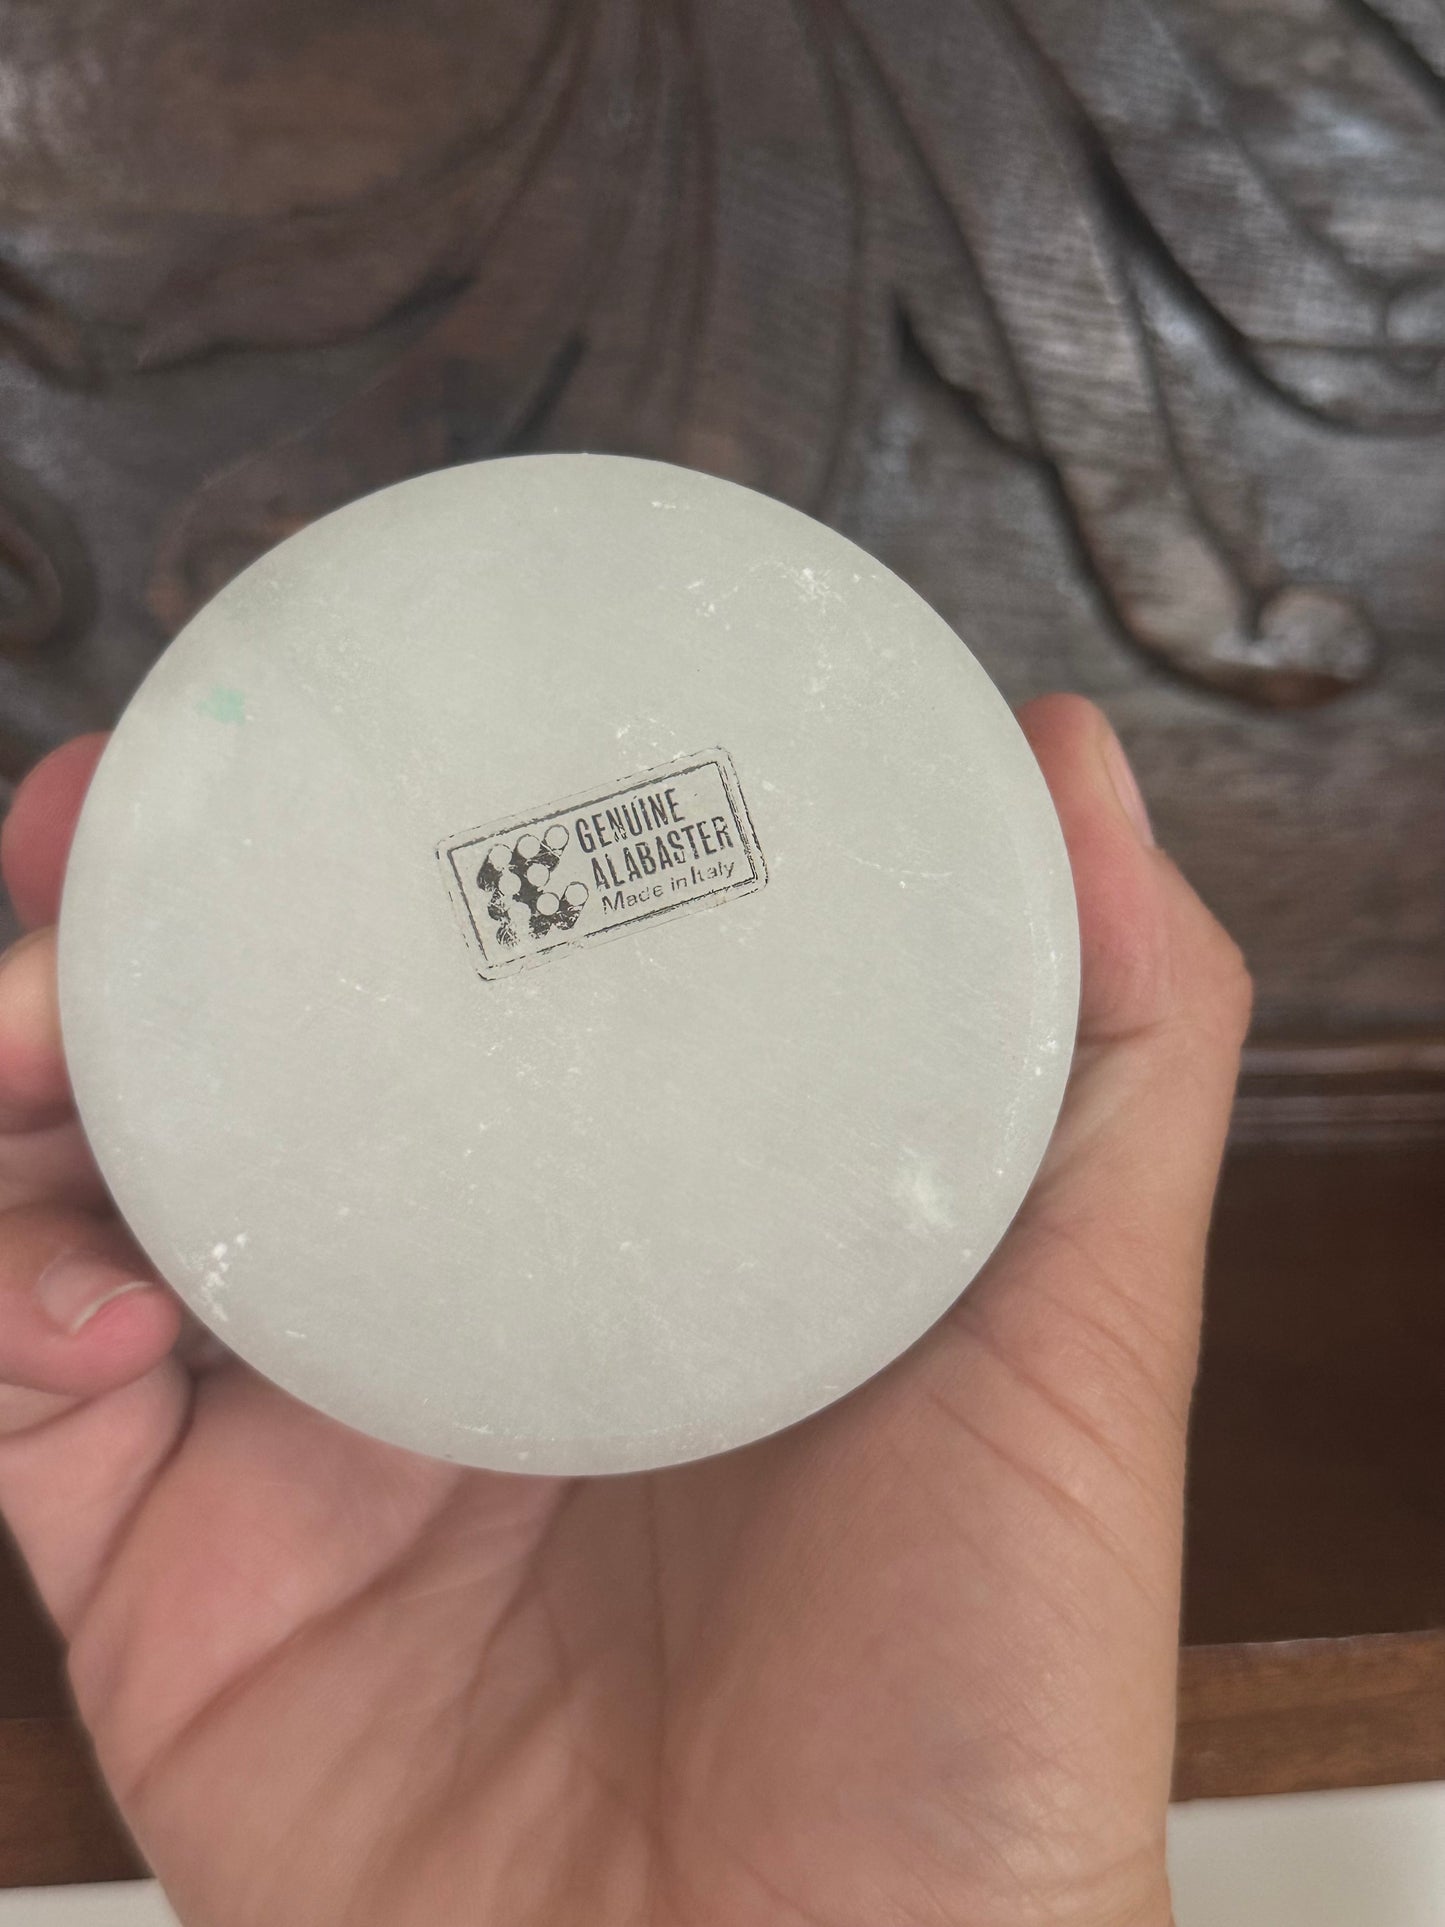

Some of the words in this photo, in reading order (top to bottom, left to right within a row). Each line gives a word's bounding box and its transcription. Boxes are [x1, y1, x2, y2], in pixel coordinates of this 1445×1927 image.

[575, 788, 685, 854] GENUINE
[591, 816, 734, 890] ALABASTER
[601, 885, 663, 915] Made
[670, 876, 688, 892] in
[690, 861, 735, 886] Italy
